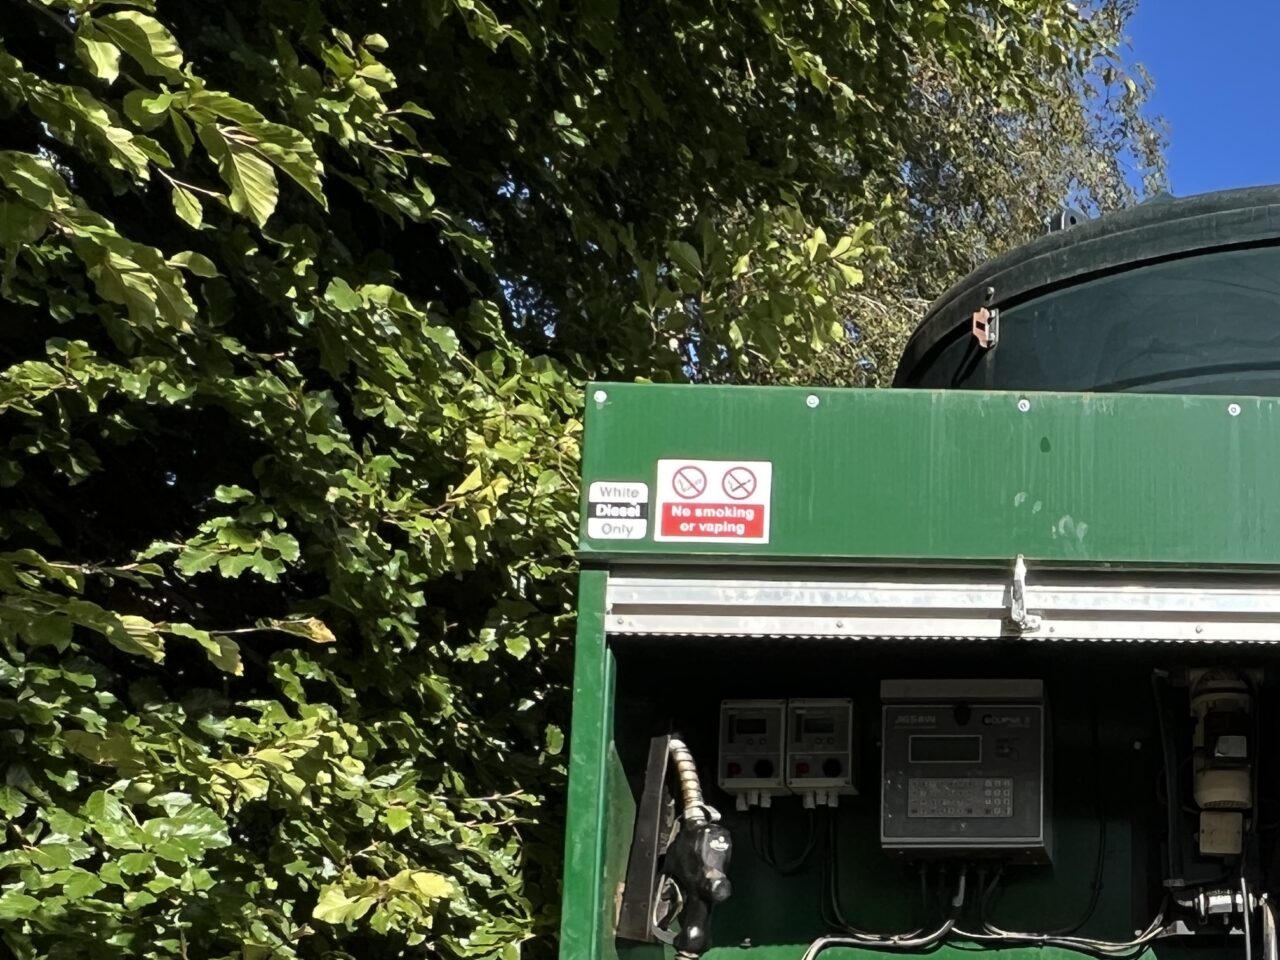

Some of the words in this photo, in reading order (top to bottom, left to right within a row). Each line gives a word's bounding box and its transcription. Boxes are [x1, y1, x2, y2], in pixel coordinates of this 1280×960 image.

[600, 486, 640, 498] White
[596, 503, 640, 517] Diesel
[671, 505, 692, 517] No
[695, 506, 755, 521] smoking
[601, 522, 634, 538] Only
[680, 521, 696, 532] or
[699, 521, 746, 535] vaping
